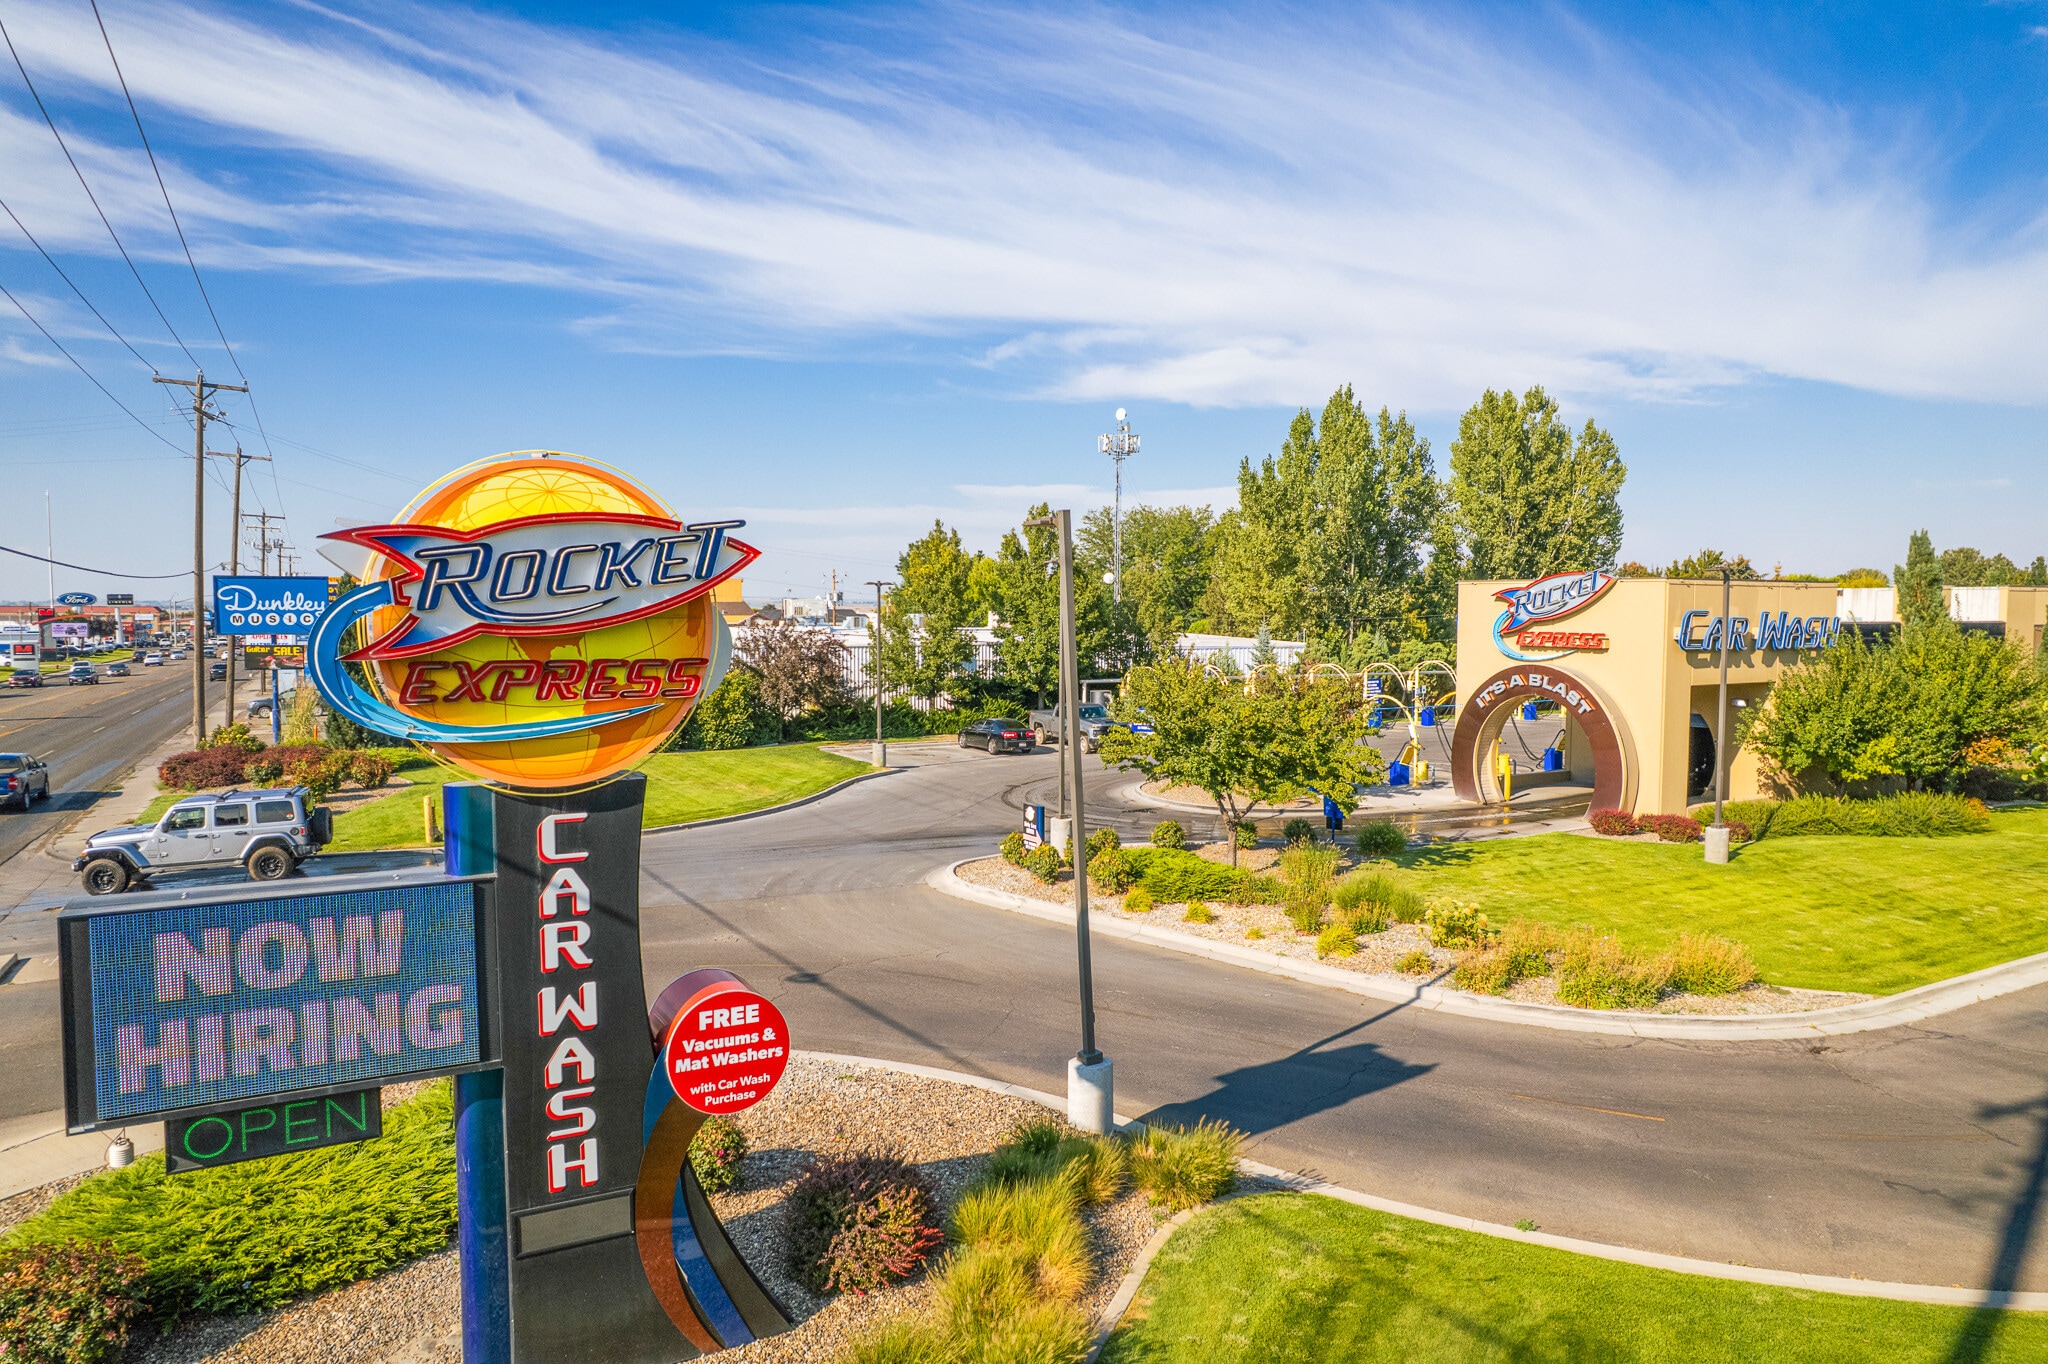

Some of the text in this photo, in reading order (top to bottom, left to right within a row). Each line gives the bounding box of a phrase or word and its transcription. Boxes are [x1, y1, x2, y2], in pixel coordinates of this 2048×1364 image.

[413, 519, 747, 622] ROCKET
[65, 595, 89, 603] Ford
[217, 585, 325, 617] Dunkley
[231, 614, 312, 624] MUSIC
[1678, 610, 1750, 651] CAR
[273, 646, 300, 656] SALE
[1516, 632, 1606, 649] EXPRESS
[399, 657, 709, 706] EXPRESS
[1510, 674, 1525, 688] A
[1529, 673, 1594, 714] BLAST
[153, 909, 404, 1002] NOW
[537, 813, 598, 1193] CAR WASH
[699, 1003, 760, 1031] FREE
[116, 984, 464, 1094] HIRING
[682, 1027, 776, 1053] Vacuums &
[675, 1046, 783, 1073] Mat Washers
[690, 1073, 770, 1095] with Car Wash
[705, 1090, 756, 1106] Purchase
[183, 1092, 366, 1158] OPEN
